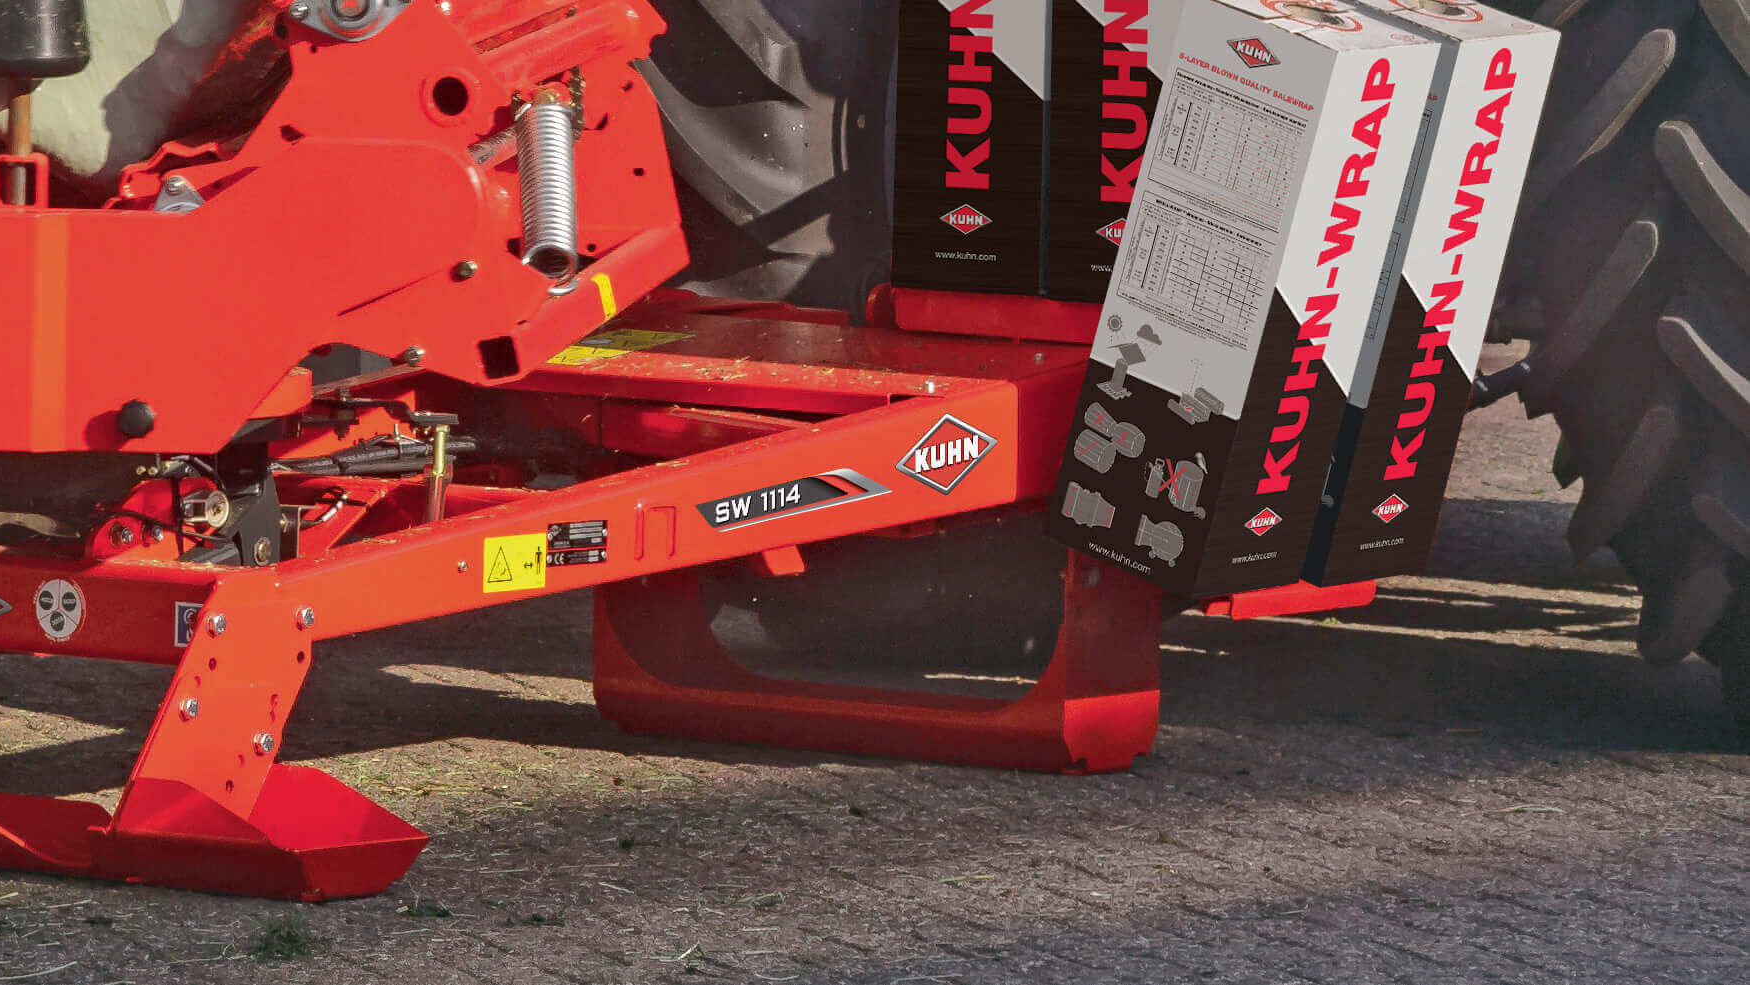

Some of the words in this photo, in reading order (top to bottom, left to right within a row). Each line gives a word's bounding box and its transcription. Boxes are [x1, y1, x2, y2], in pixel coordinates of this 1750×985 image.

[1236, 41, 1272, 64] KUHN
[1211, 65, 1239, 83] BLOWN
[1240, 77, 1272, 95] QUALITY
[1273, 90, 1314, 112] BALEWRAP
[949, 213, 983, 226] KUHN
[1105, 227, 1123, 238] KU
[934, 250, 997, 262] www.kuhn.com
[1384, 47, 1517, 481] KUHN-WRAP
[1256, 58, 1396, 496] KUHN-WRAP
[914, 434, 979, 473] KUHN
[715, 495, 752, 523] SW
[760, 483, 801, 512] 1114
[1377, 503, 1403, 516] KUHN
[1249, 516, 1277, 529] KUHN
[1359, 537, 1405, 551] www.kuhn.com
[1088, 541, 1151, 575] www.kuhn.com
